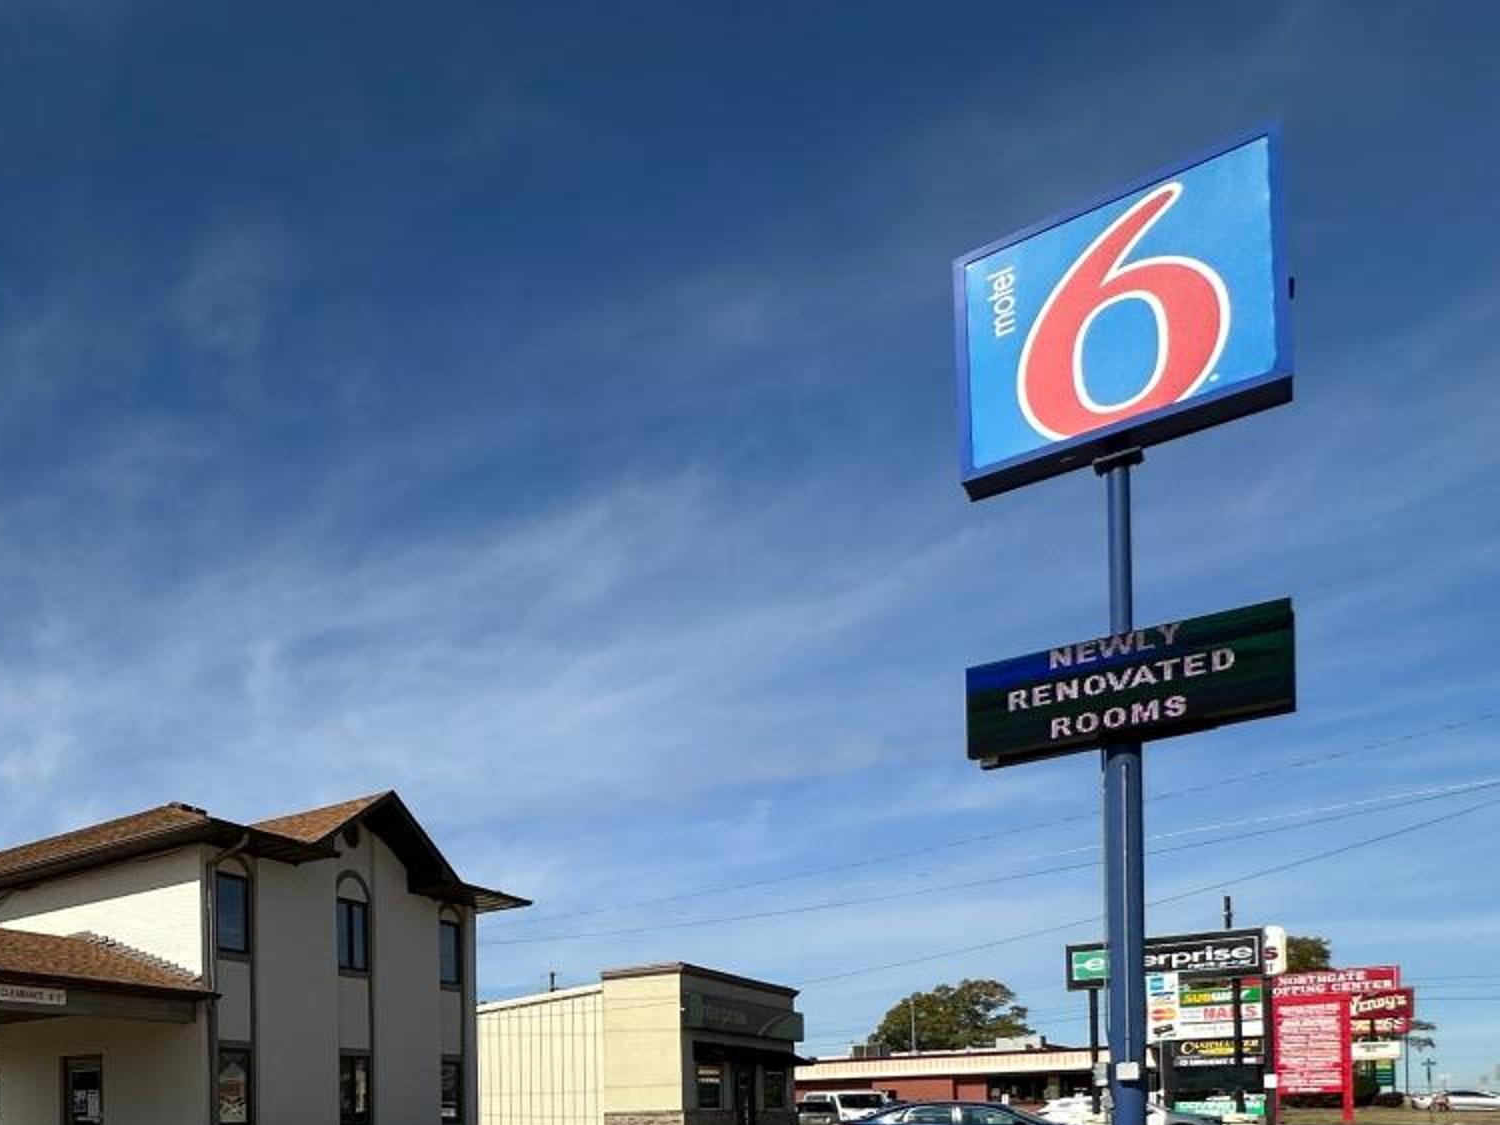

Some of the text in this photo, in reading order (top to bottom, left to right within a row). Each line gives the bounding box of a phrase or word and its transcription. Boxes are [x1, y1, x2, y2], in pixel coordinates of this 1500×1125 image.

[989, 265, 1015, 337] motel
[1016, 181, 1231, 440] 6
[1049, 622, 1183, 670] NEWLY
[1006, 647, 1236, 712] RENOVATED
[1049, 695, 1189, 739] ROOMS
[1272, 979, 1393, 997] OPPING CENTER
[1278, 971, 1367, 986] NORTHGATE
[1203, 1005, 1258, 1019] NAS
